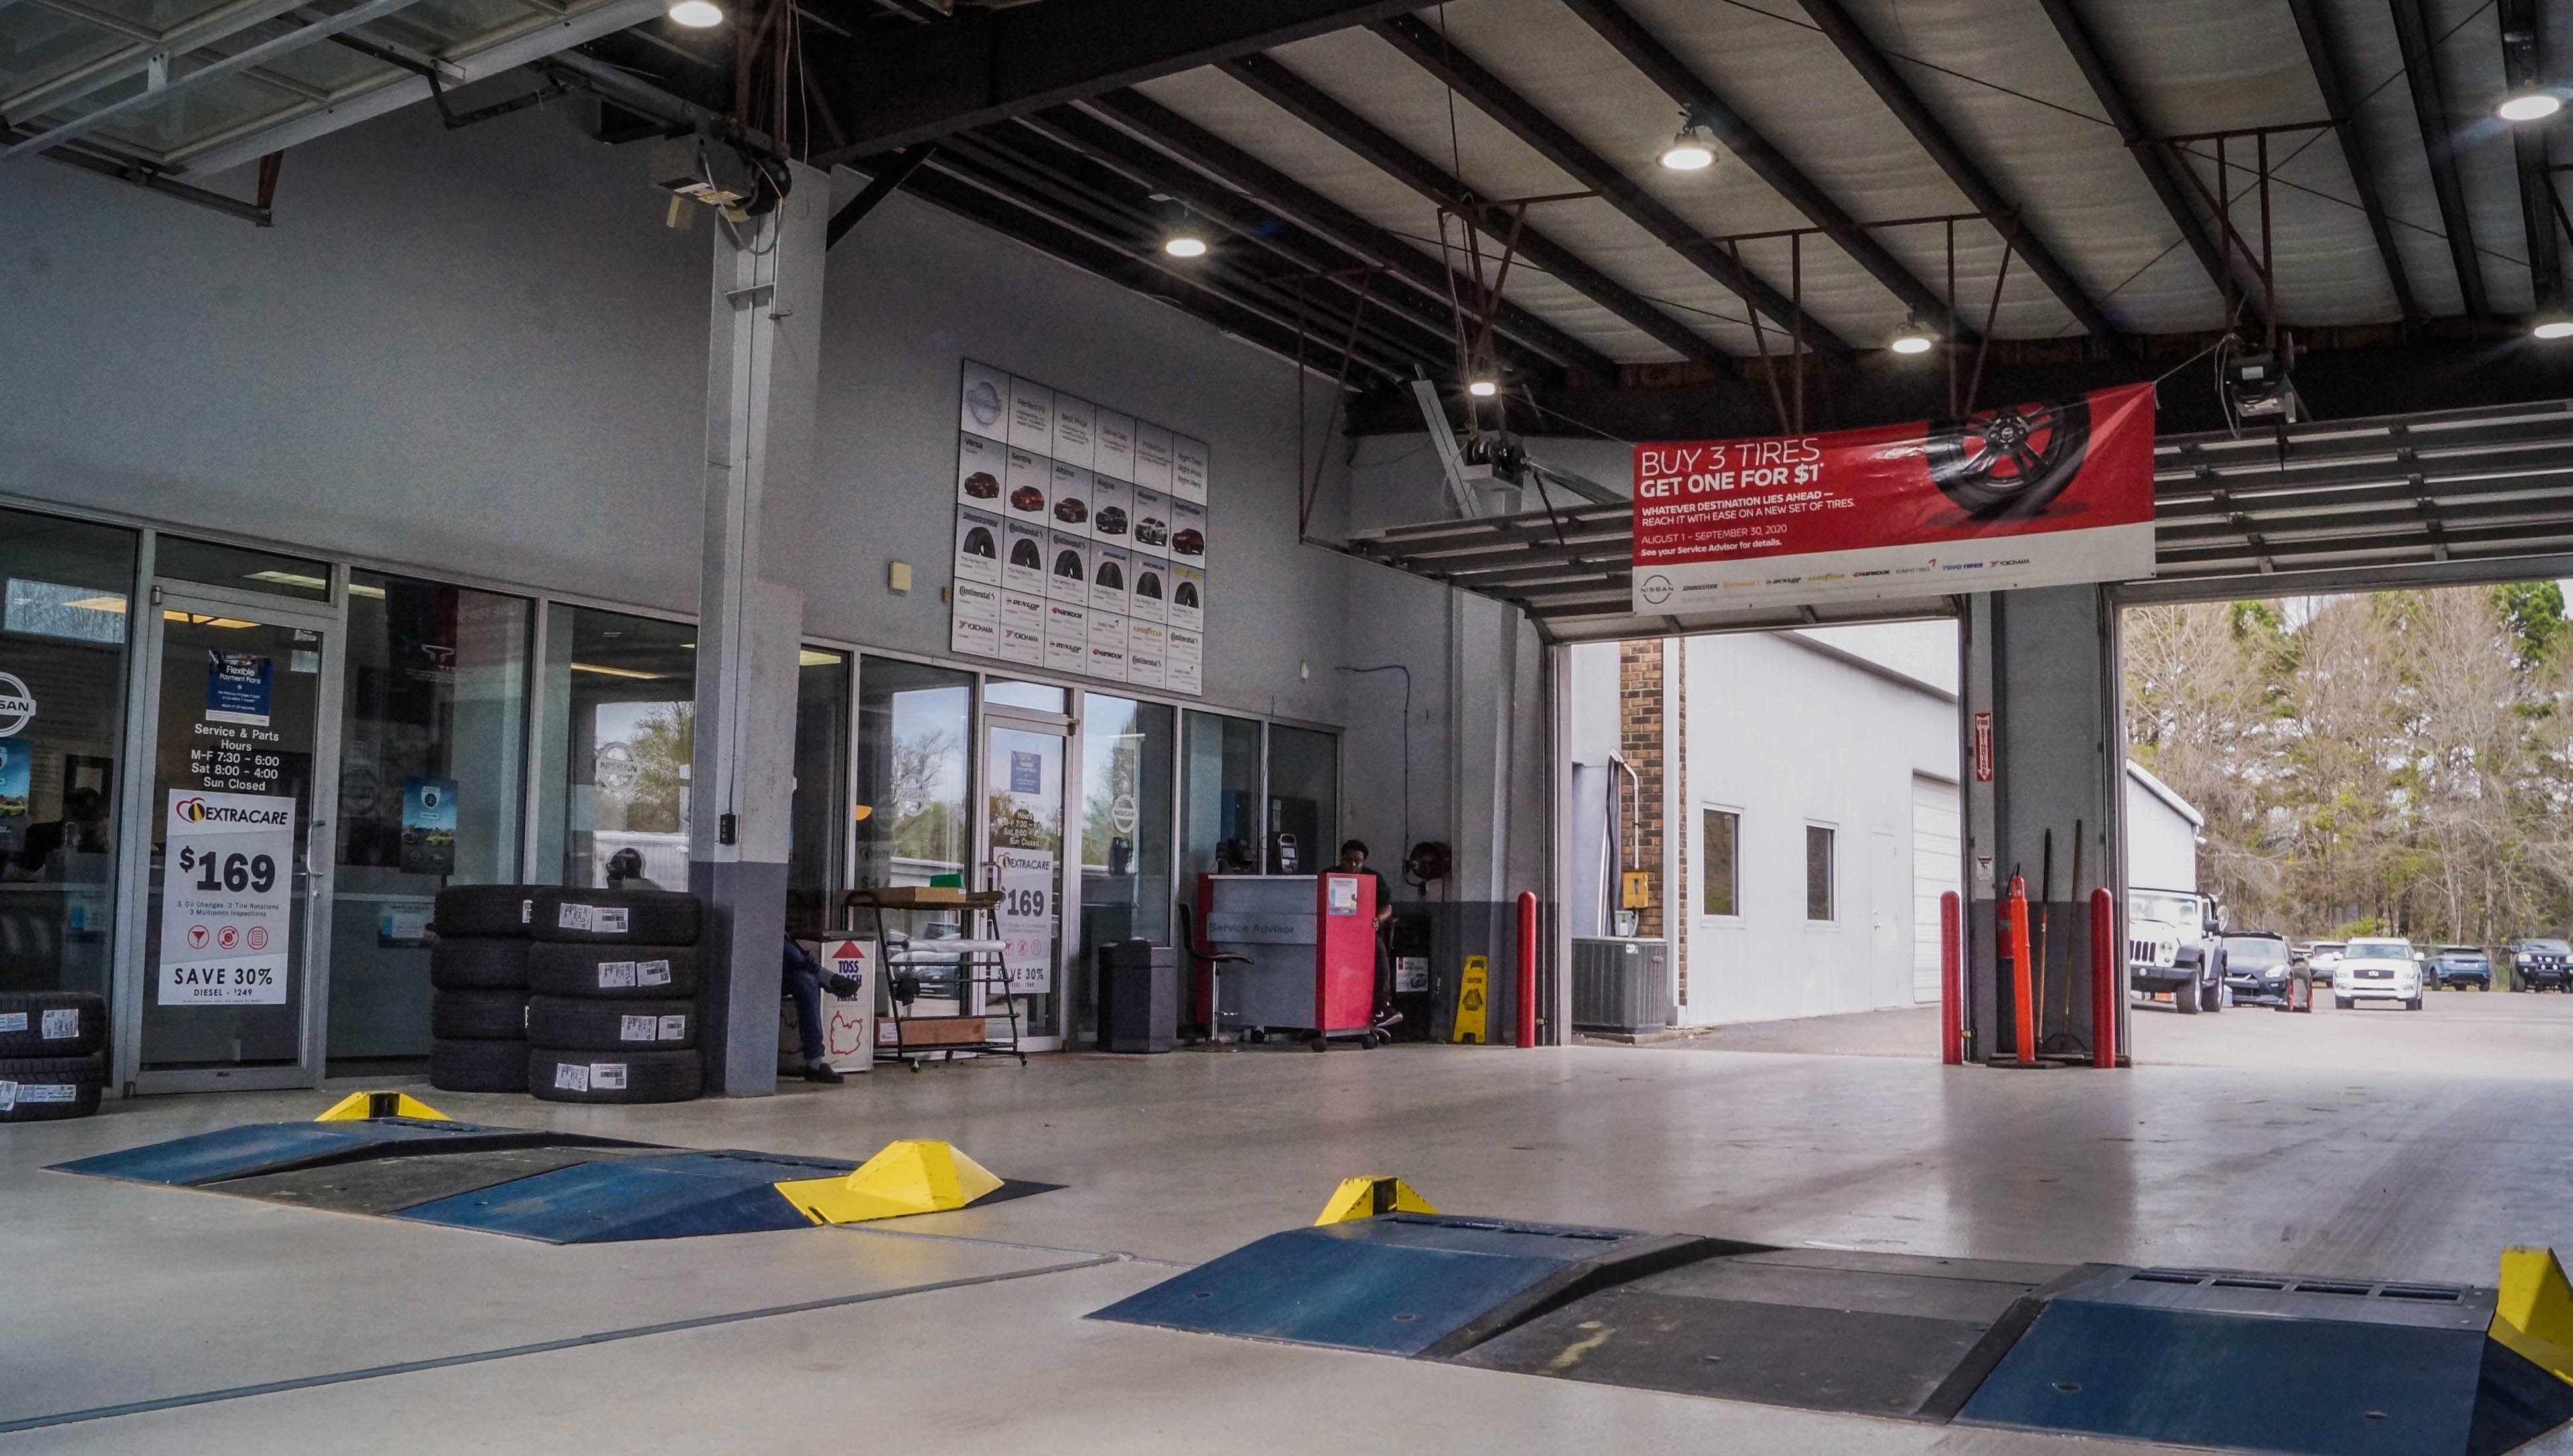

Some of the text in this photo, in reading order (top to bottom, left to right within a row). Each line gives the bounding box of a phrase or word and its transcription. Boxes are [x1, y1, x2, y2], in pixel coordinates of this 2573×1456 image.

[1641, 438, 1820, 477] BUY 3 TIRES
[1640, 476, 1683, 498] GET
[1687, 472, 1735, 494] ONE
[1741, 468, 1789, 488] FOR
[1641, 503, 1696, 517] WHATEVER
[1697, 496, 1761, 512] DESTINATION
[1763, 494, 1783, 504] LIES
[1785, 491, 1822, 502] AHEAD
[1641, 498, 1856, 527] REACH IT WITH EASE ON A NEW SET OF TIRES.
[1641, 533, 1679, 545] AUGUST
[1695, 527, 1748, 541] SEPTEMBER
[1750, 526, 1764, 537] 30,
[1765, 524, 1787, 534] 2020
[1641, 538, 1782, 558] See your Service Advisor for details.
[2000, 558, 2030, 567] YOKOHAMA
[1012, 599, 1040, 611] DUNLOP
[966, 622, 994, 634] YOKOHAMA
[1013, 631, 1039, 643] YOKOHAMA
[1056, 641, 1082, 653] DUNLOP
[220, 673, 245, 682] Payment
[226, 665, 255, 677] Flexible
[194, 723, 279, 742] Service & Parts
[221, 739, 252, 752] Hours
[191, 749, 214, 761] M-F
[218, 752, 241, 763] 7:30
[255, 755, 279, 767] 6:00
[191, 762, 210, 774] Sat
[214, 765, 240, 776] 8:00
[253, 768, 279, 779] 4:00
[204, 776, 265, 791] Sun Closed
[205, 807, 288, 825] EXTRACARE
[178, 845, 276, 893] $169
[1010, 858, 1050, 871] EXTRACARE
[196, 901, 224, 909] Changes
[1253, 923, 1294, 934] Advisor
[838, 960, 859, 974] TOSS
[1025, 968, 1044, 980] 30%
[173, 967, 273, 986] SAVE 30%
